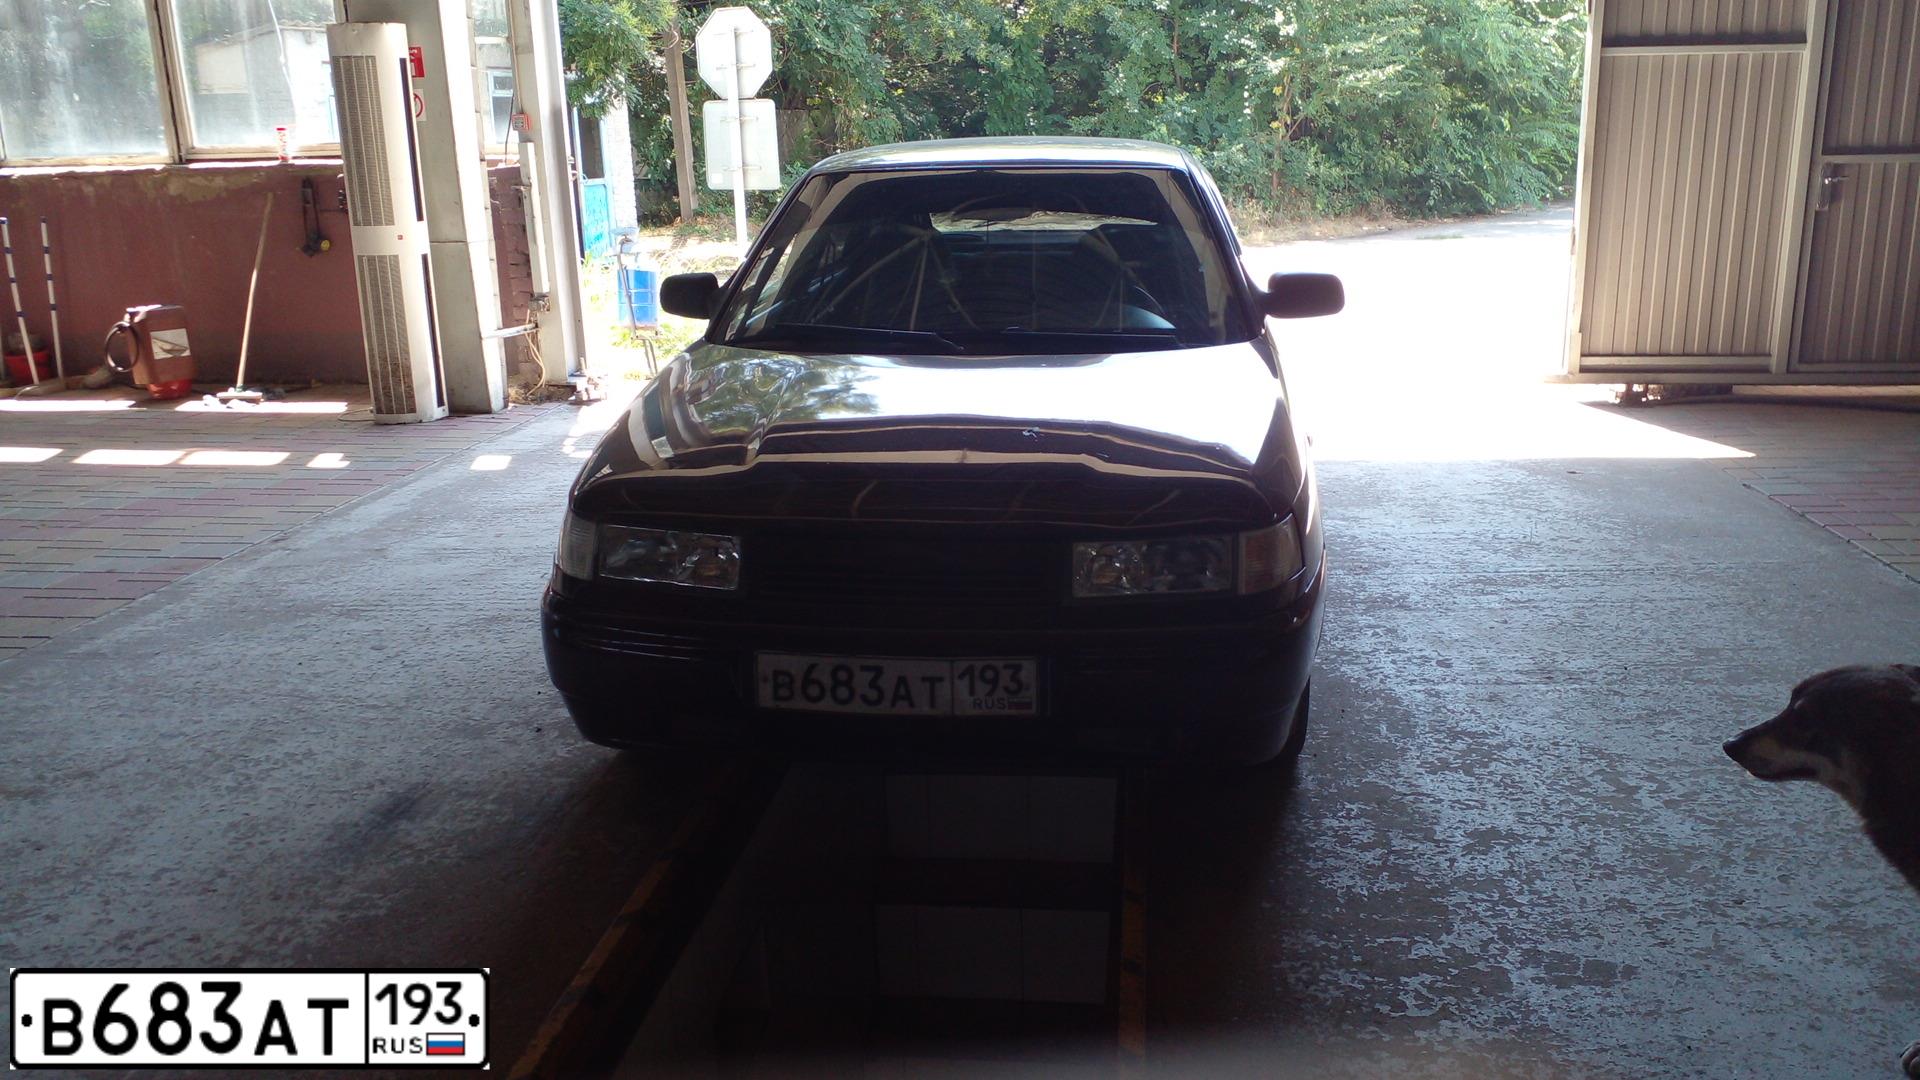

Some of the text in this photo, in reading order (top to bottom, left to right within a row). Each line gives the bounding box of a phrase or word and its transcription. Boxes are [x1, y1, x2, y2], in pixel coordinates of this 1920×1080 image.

[771, 662, 1024, 709] B683AT 193
[972, 697, 1006, 710] RUS
